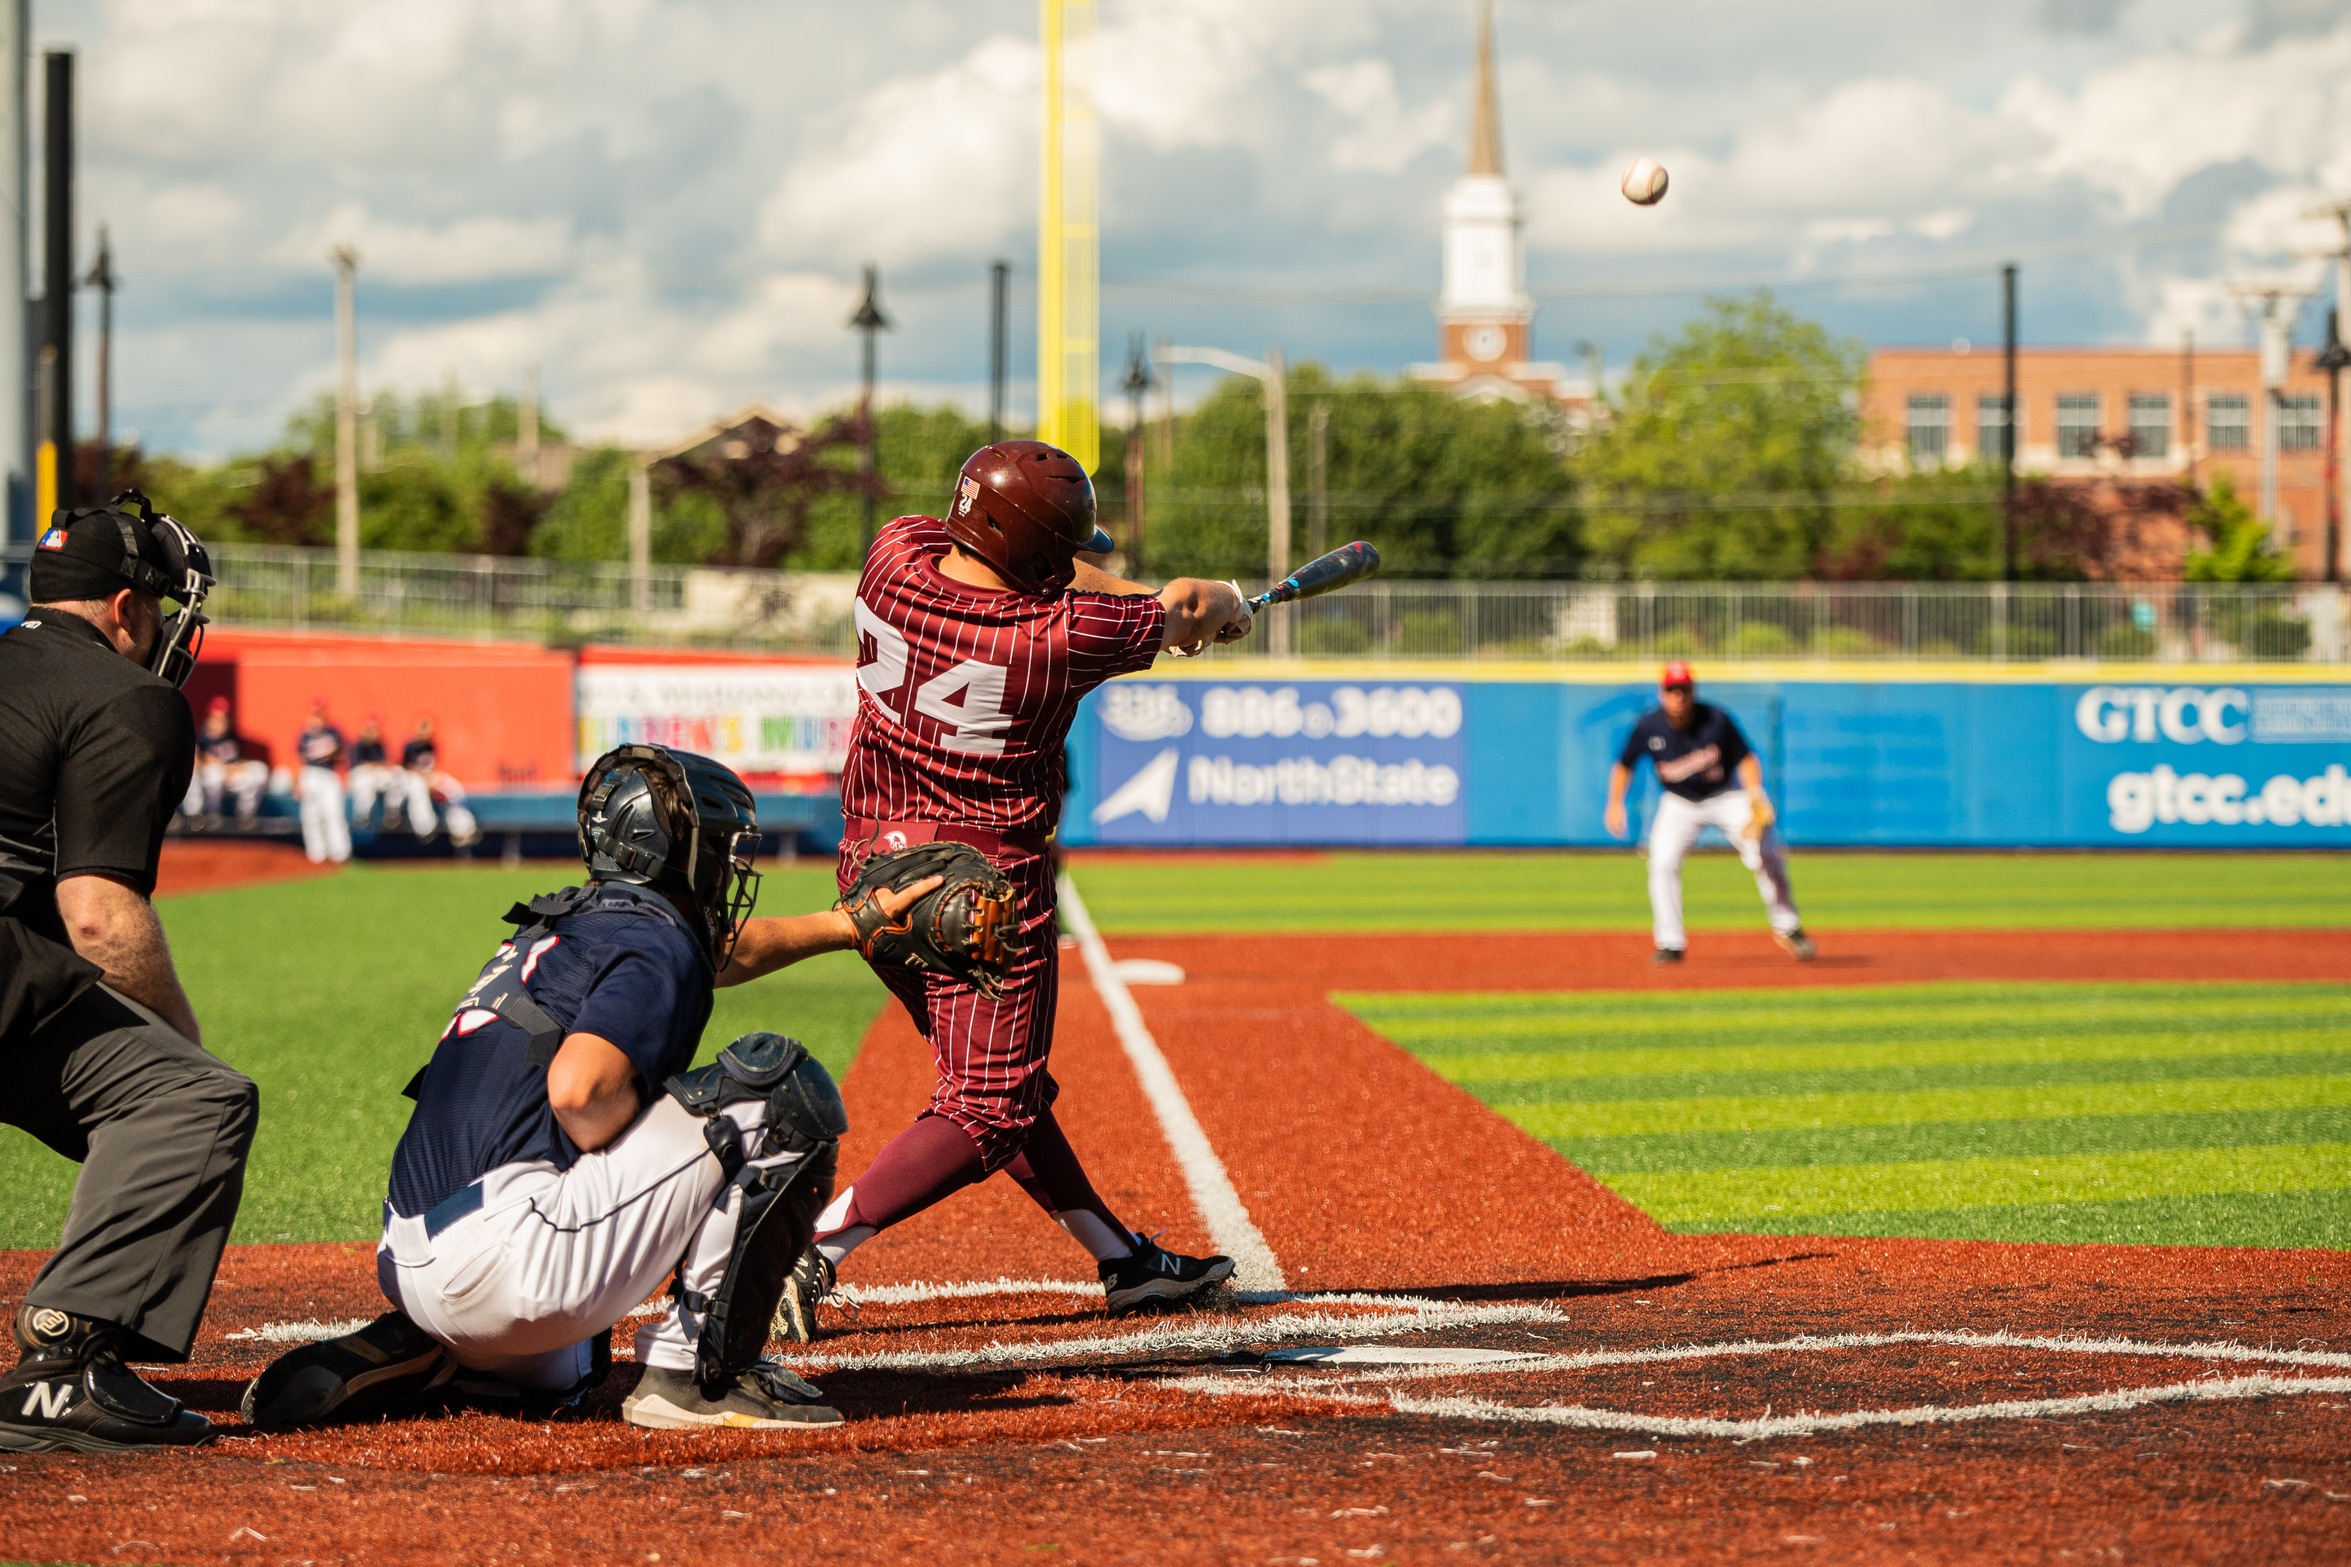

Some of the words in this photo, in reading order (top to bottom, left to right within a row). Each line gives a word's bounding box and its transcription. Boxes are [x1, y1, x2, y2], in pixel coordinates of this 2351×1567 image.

[854, 595, 1014, 755] 24
[2076, 686, 2249, 745] GTCC
[1187, 754, 1460, 806] NorthState
[2106, 763, 2351, 833] gtcc.ed
[1161, 1253, 1181, 1276] N
[21, 1381, 73, 1419] N
